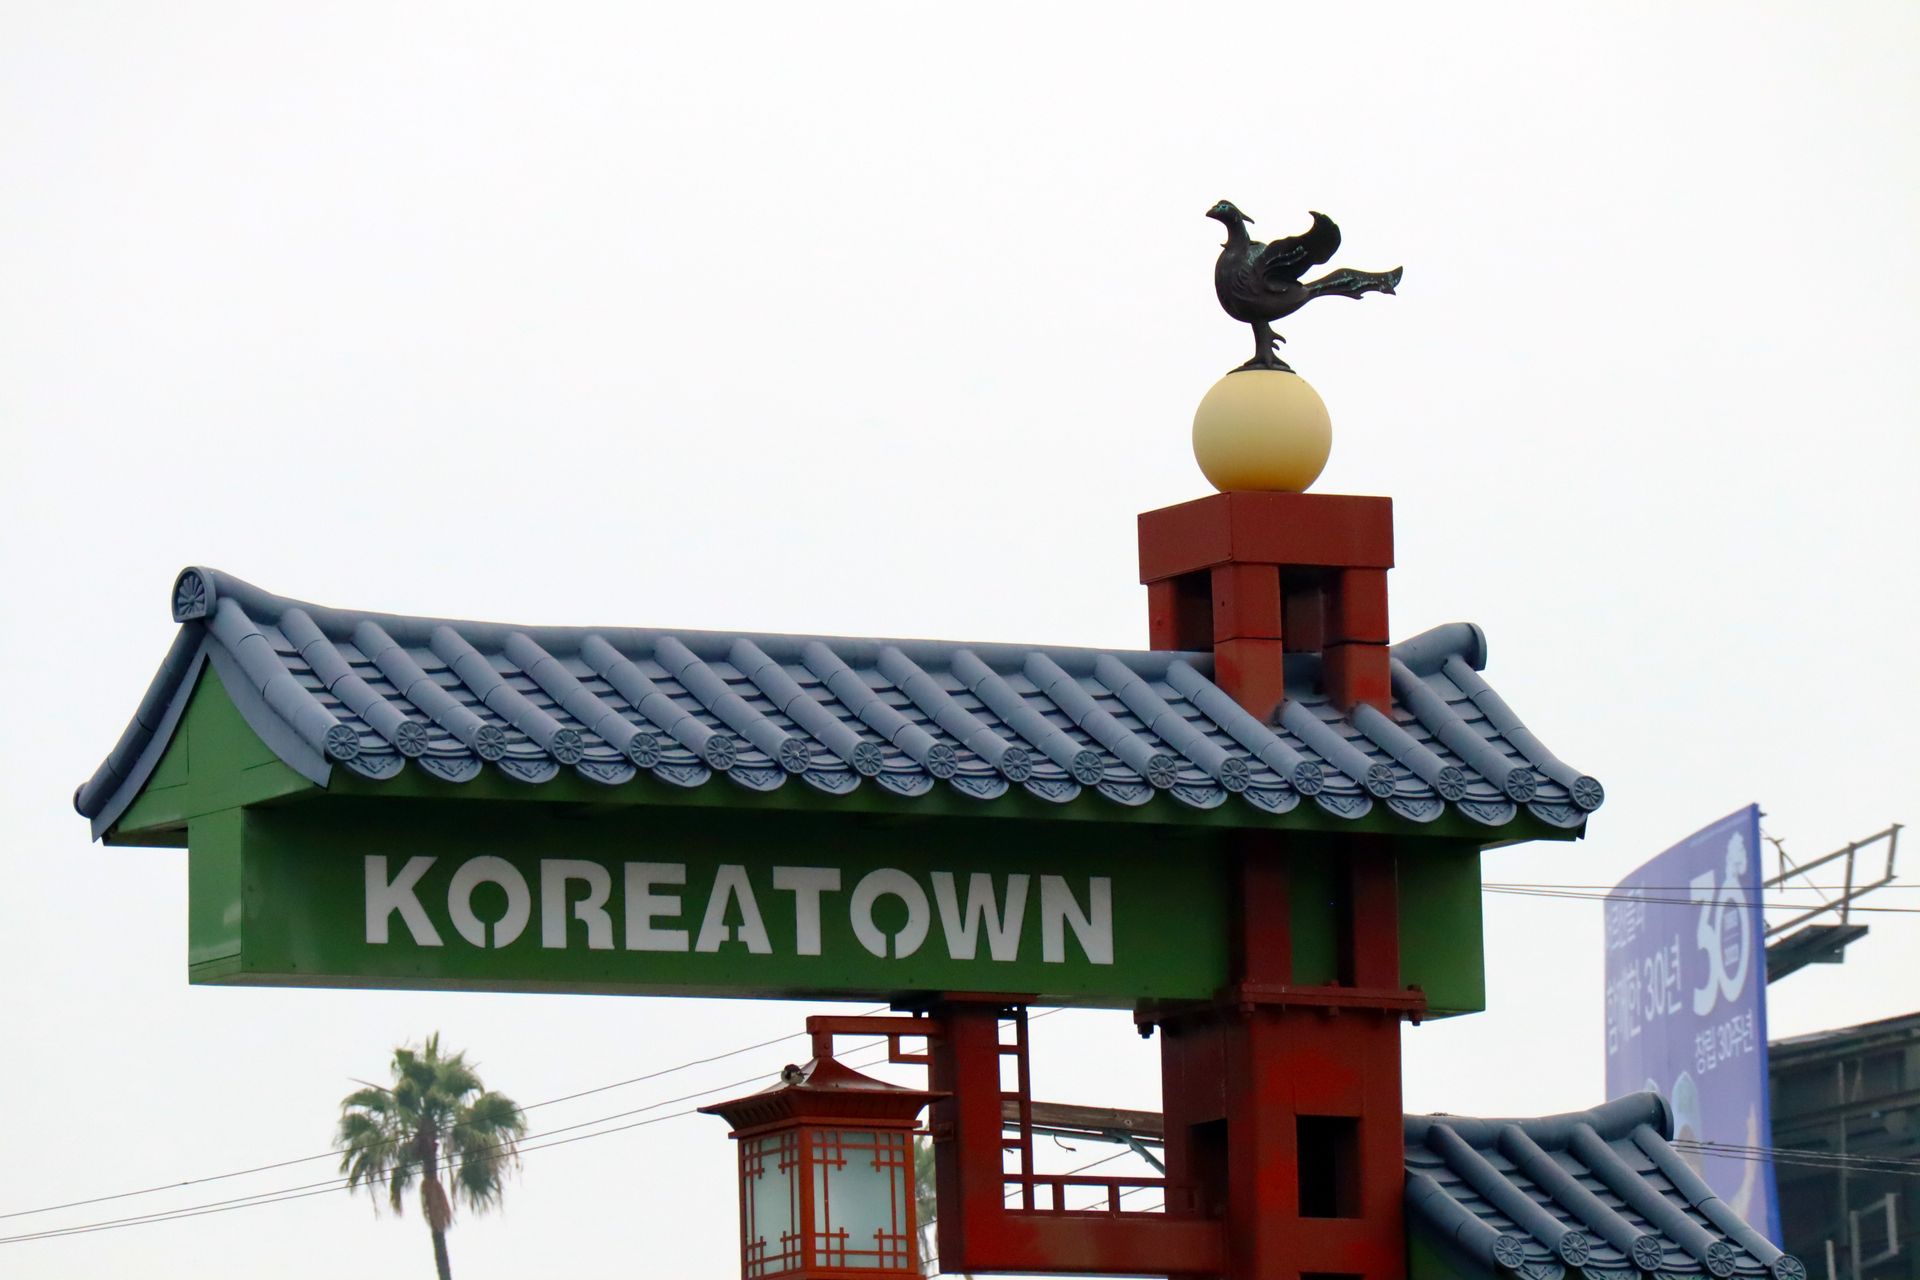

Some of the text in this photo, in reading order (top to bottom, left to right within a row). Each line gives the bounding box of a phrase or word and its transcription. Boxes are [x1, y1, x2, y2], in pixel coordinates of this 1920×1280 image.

[364, 855, 1115, 966] KOREATOWN
[1689, 869, 1749, 1017] 30
[1644, 933, 1682, 1022] 30년
[1695, 1008, 1754, 1075] 창립 30주년
